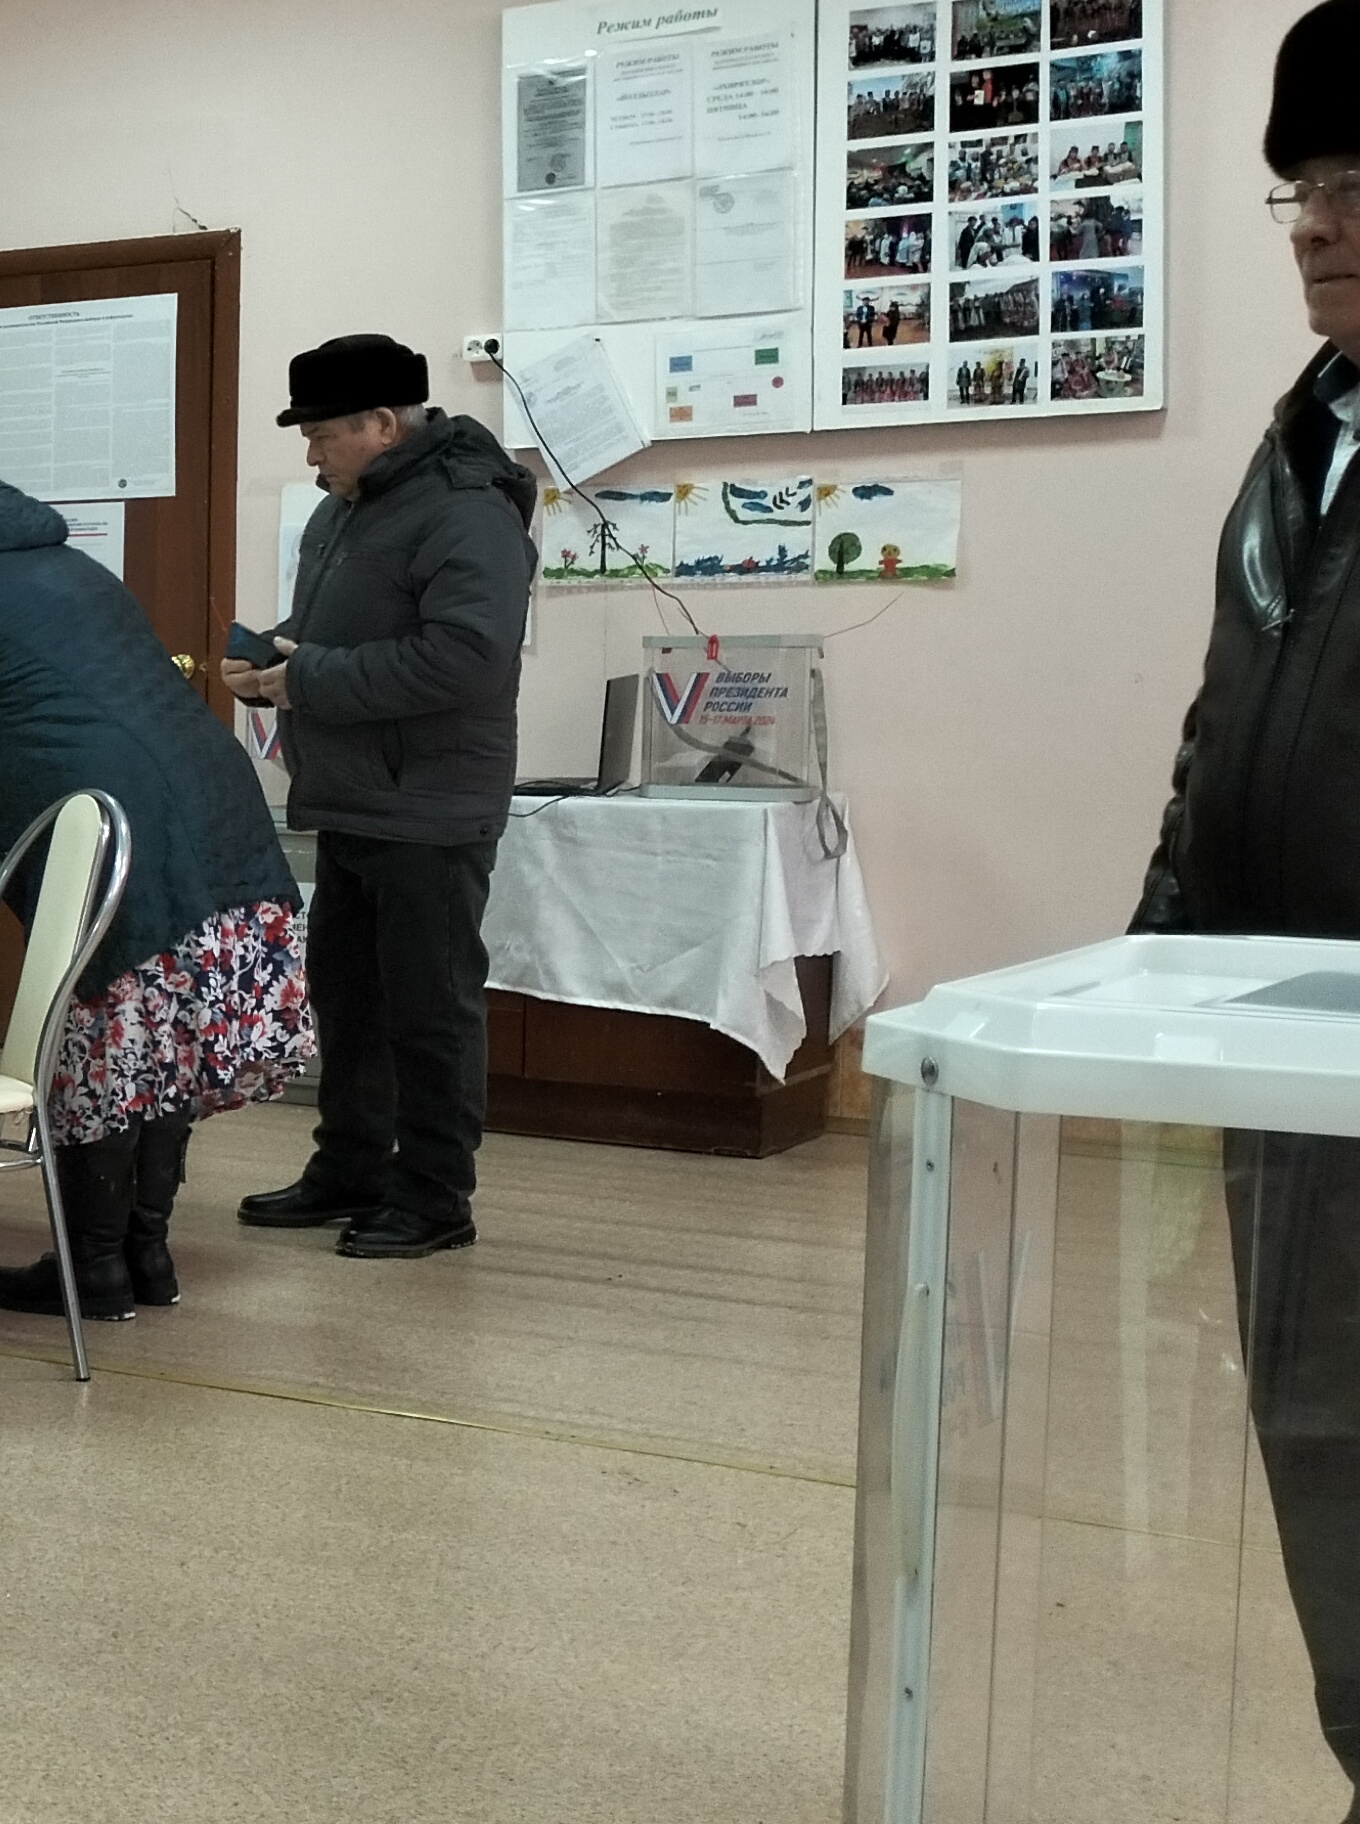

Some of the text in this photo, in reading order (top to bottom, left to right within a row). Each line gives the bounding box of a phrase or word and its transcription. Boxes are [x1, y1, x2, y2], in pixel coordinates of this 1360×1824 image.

[597, 7, 719, 35] Режим работы
[715, 672, 772, 684] ВЫБОРЫ
[709, 686, 789, 699] ПРЕЗИДЕНТА
[703, 701, 753, 713] РОССИИ
